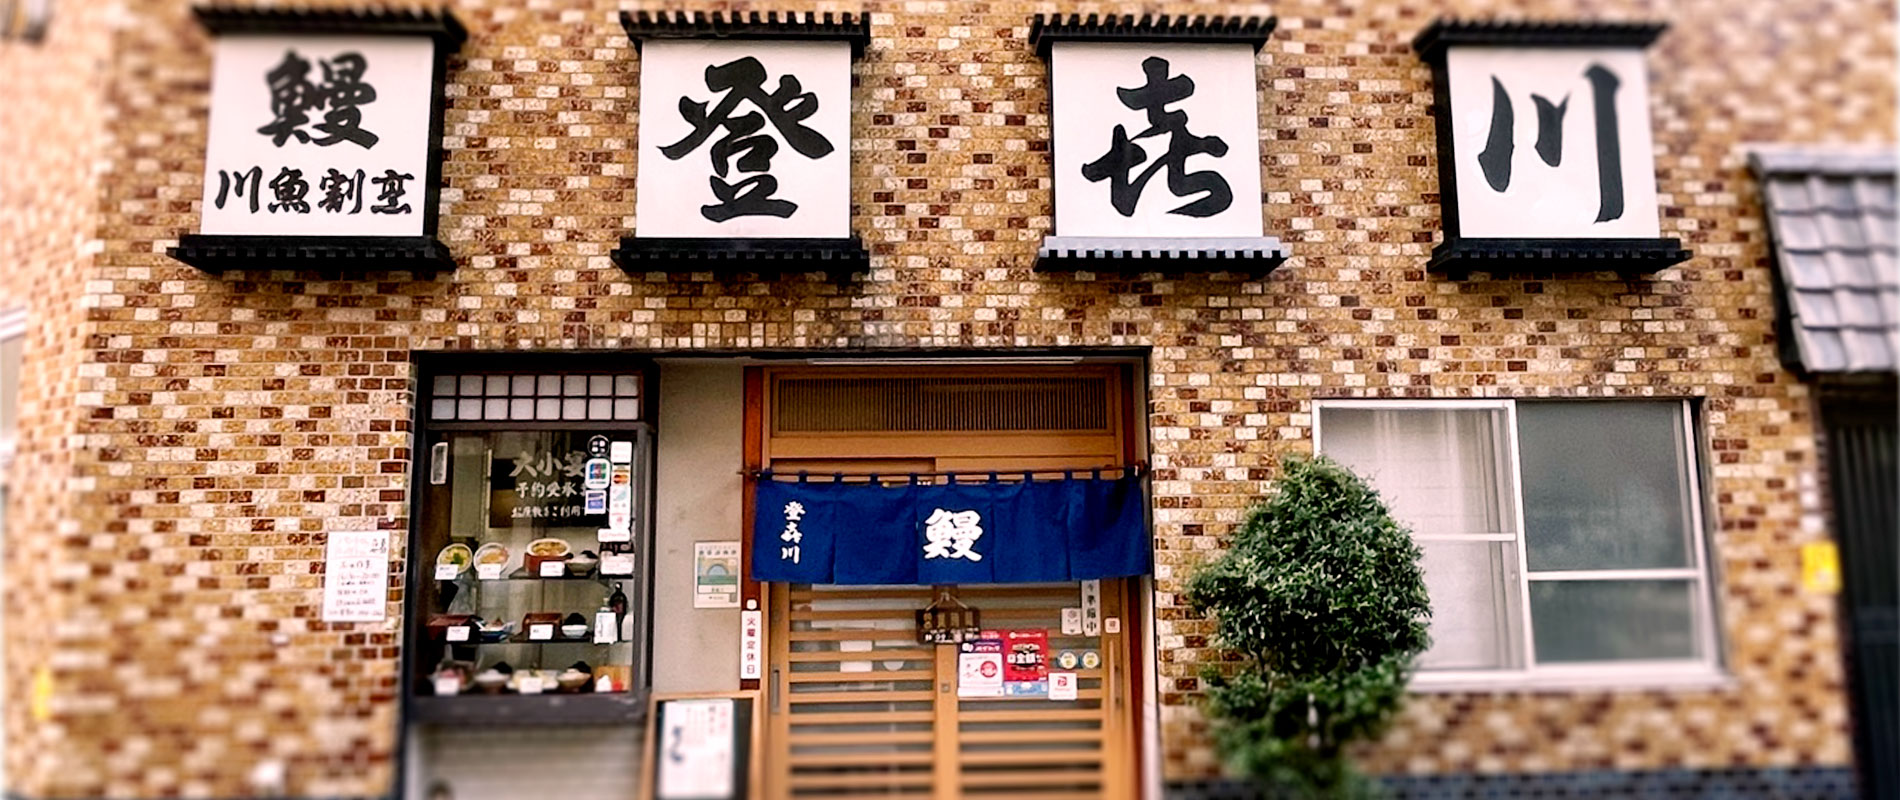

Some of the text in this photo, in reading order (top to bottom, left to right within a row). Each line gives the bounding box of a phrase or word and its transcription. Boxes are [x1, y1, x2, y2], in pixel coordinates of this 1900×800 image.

[257, 49, 379, 149] 鰻
[656, 56, 834, 222] 登
[1477, 62, 1624, 224] 川
[215, 166, 414, 214] 川魚割烹
[923, 508, 983, 561] 鰻
[746, 617, 756, 674] 火曜定休日
